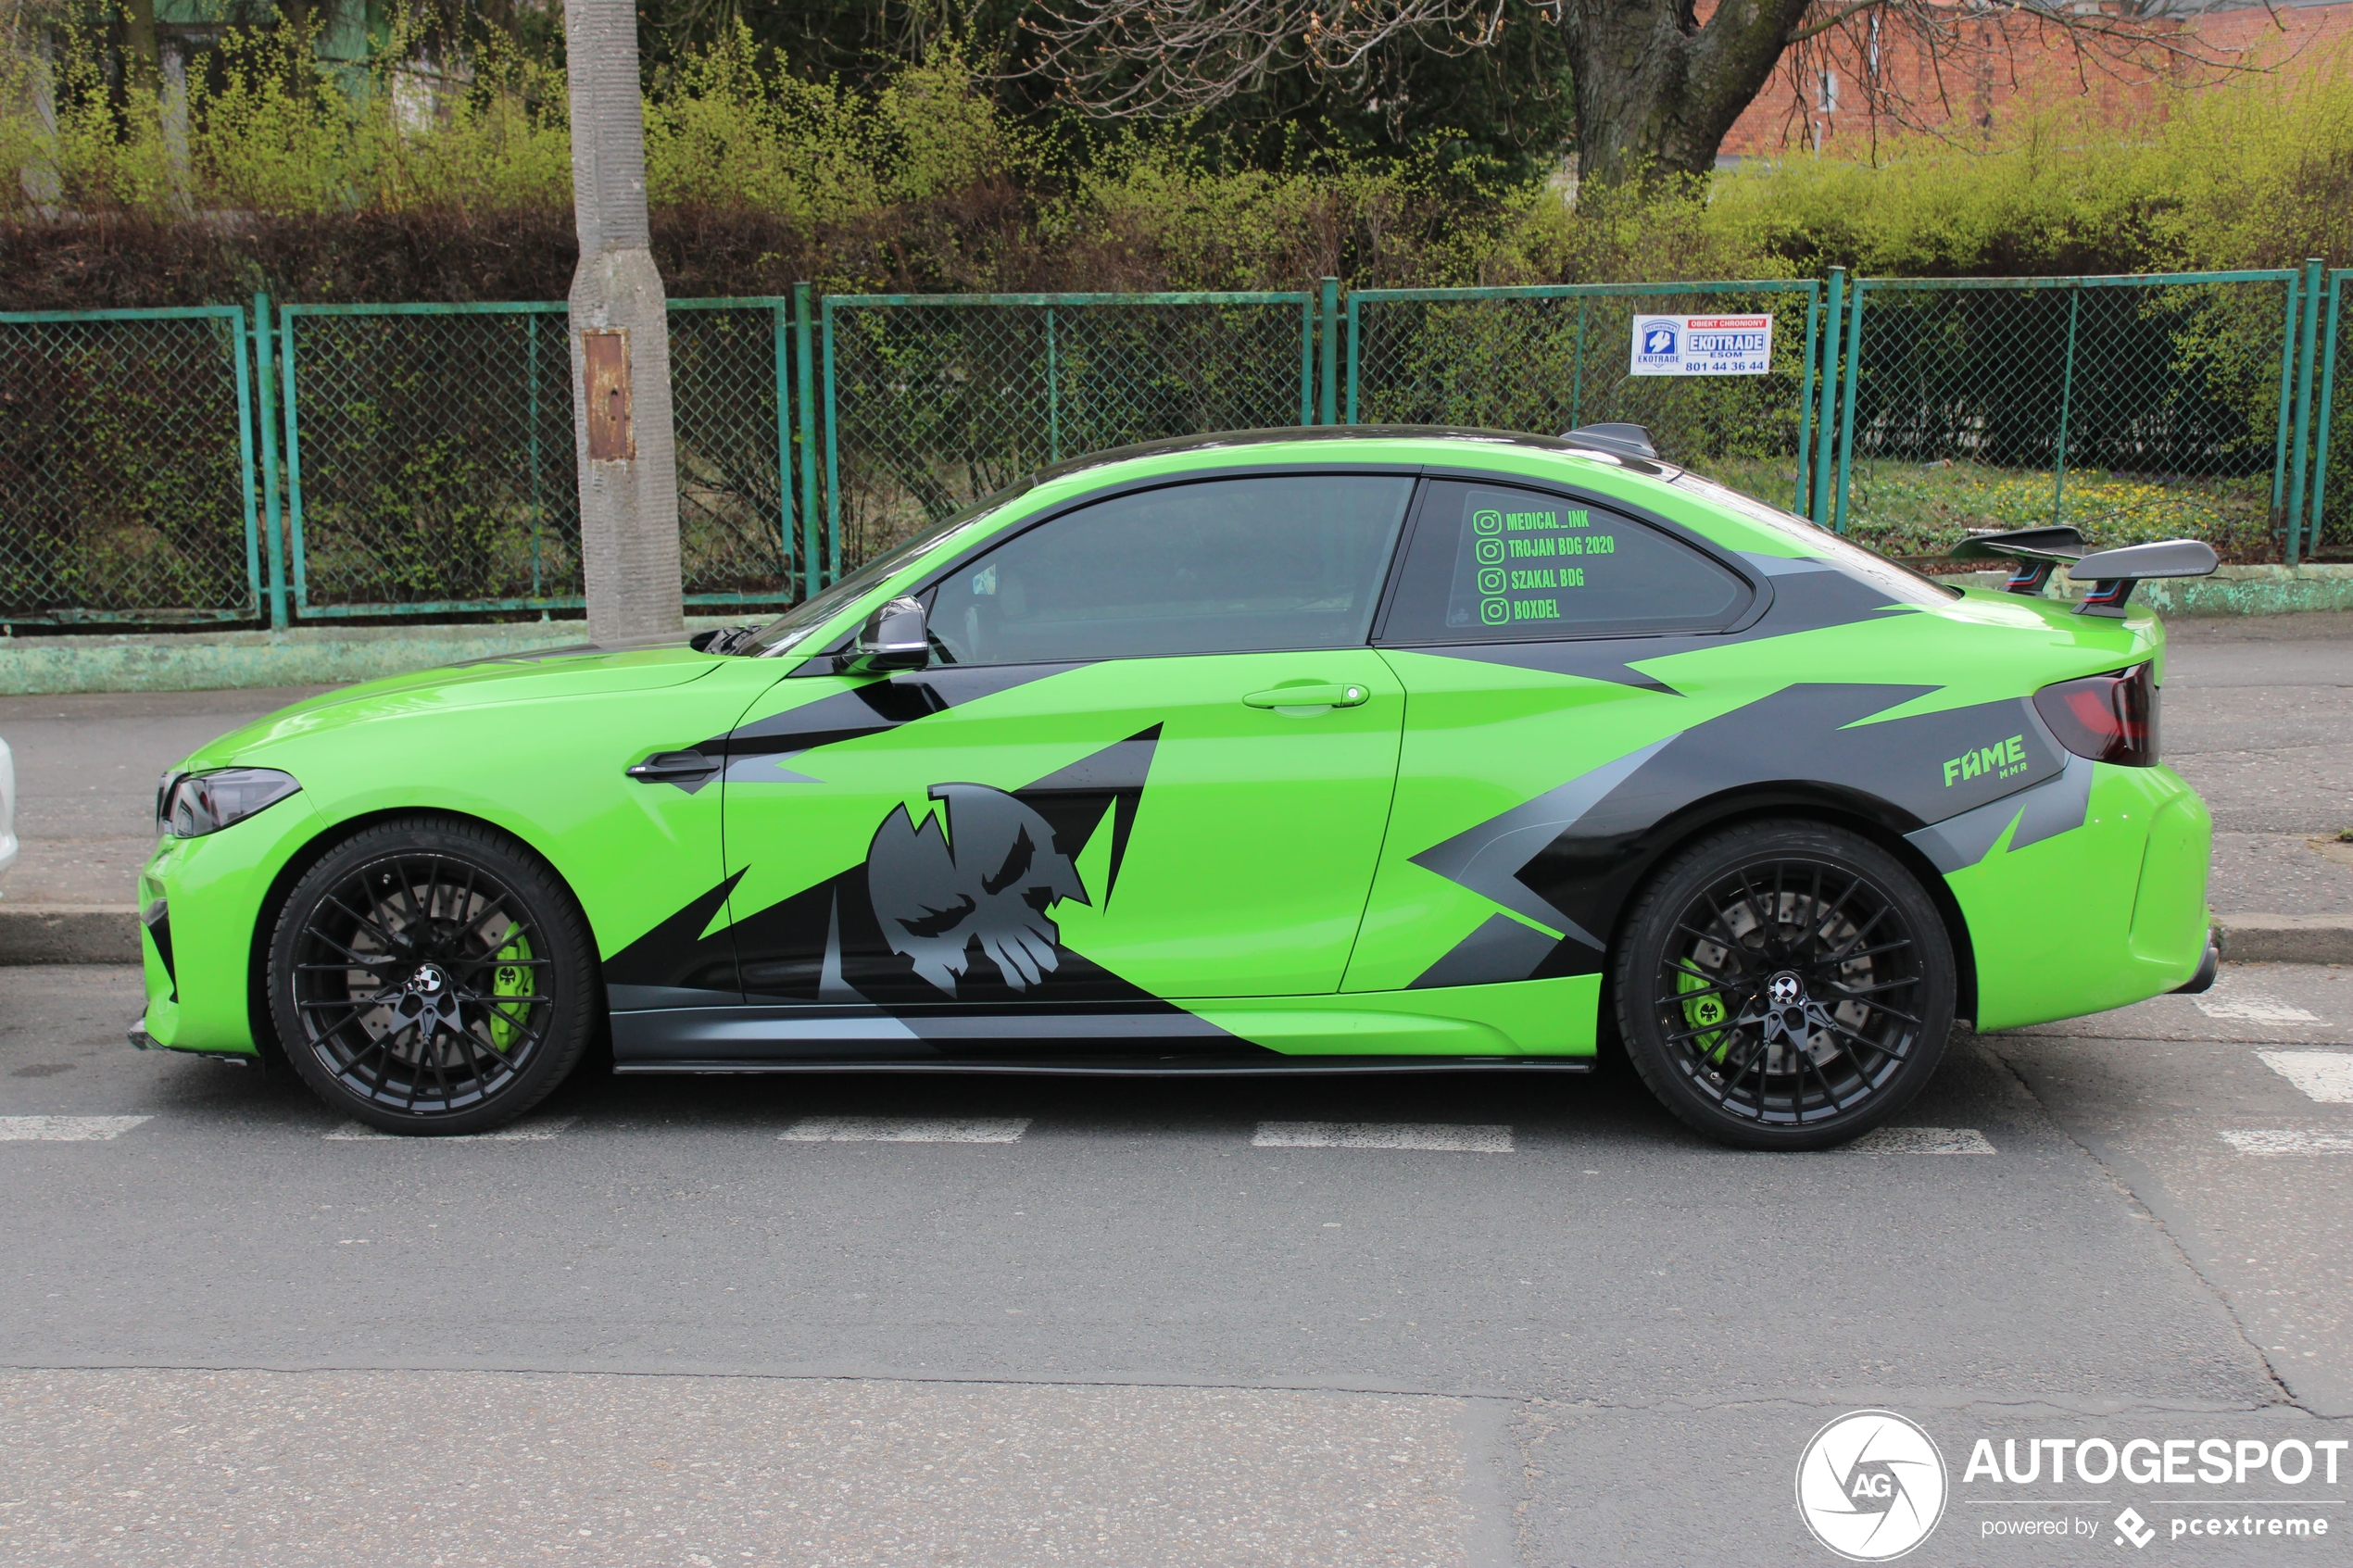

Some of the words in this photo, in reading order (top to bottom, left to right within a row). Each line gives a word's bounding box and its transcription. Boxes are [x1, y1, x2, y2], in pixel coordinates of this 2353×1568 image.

[1719, 319, 1764, 327] CHRONIONY
[1690, 334, 1763, 351] EKOTRADE
[1638, 355, 1680, 363] EKOTRADE
[1685, 362, 1707, 371] 801
[1712, 362, 1727, 371] 44
[1730, 361, 1745, 370] 36
[1749, 361, 1764, 370] 44
[1505, 509, 1590, 531] MEDICAL_INK
[1508, 537, 1555, 558] TROJAN
[1557, 536, 1583, 556] BDG
[1585, 535, 1615, 555] 2020
[1511, 569, 1557, 590] SZAKAL
[1559, 567, 1585, 587] BDG
[1514, 599, 1560, 621] BOXDEL
[1943, 734, 2026, 787] FAME
[1999, 762, 2027, 779] MMA
